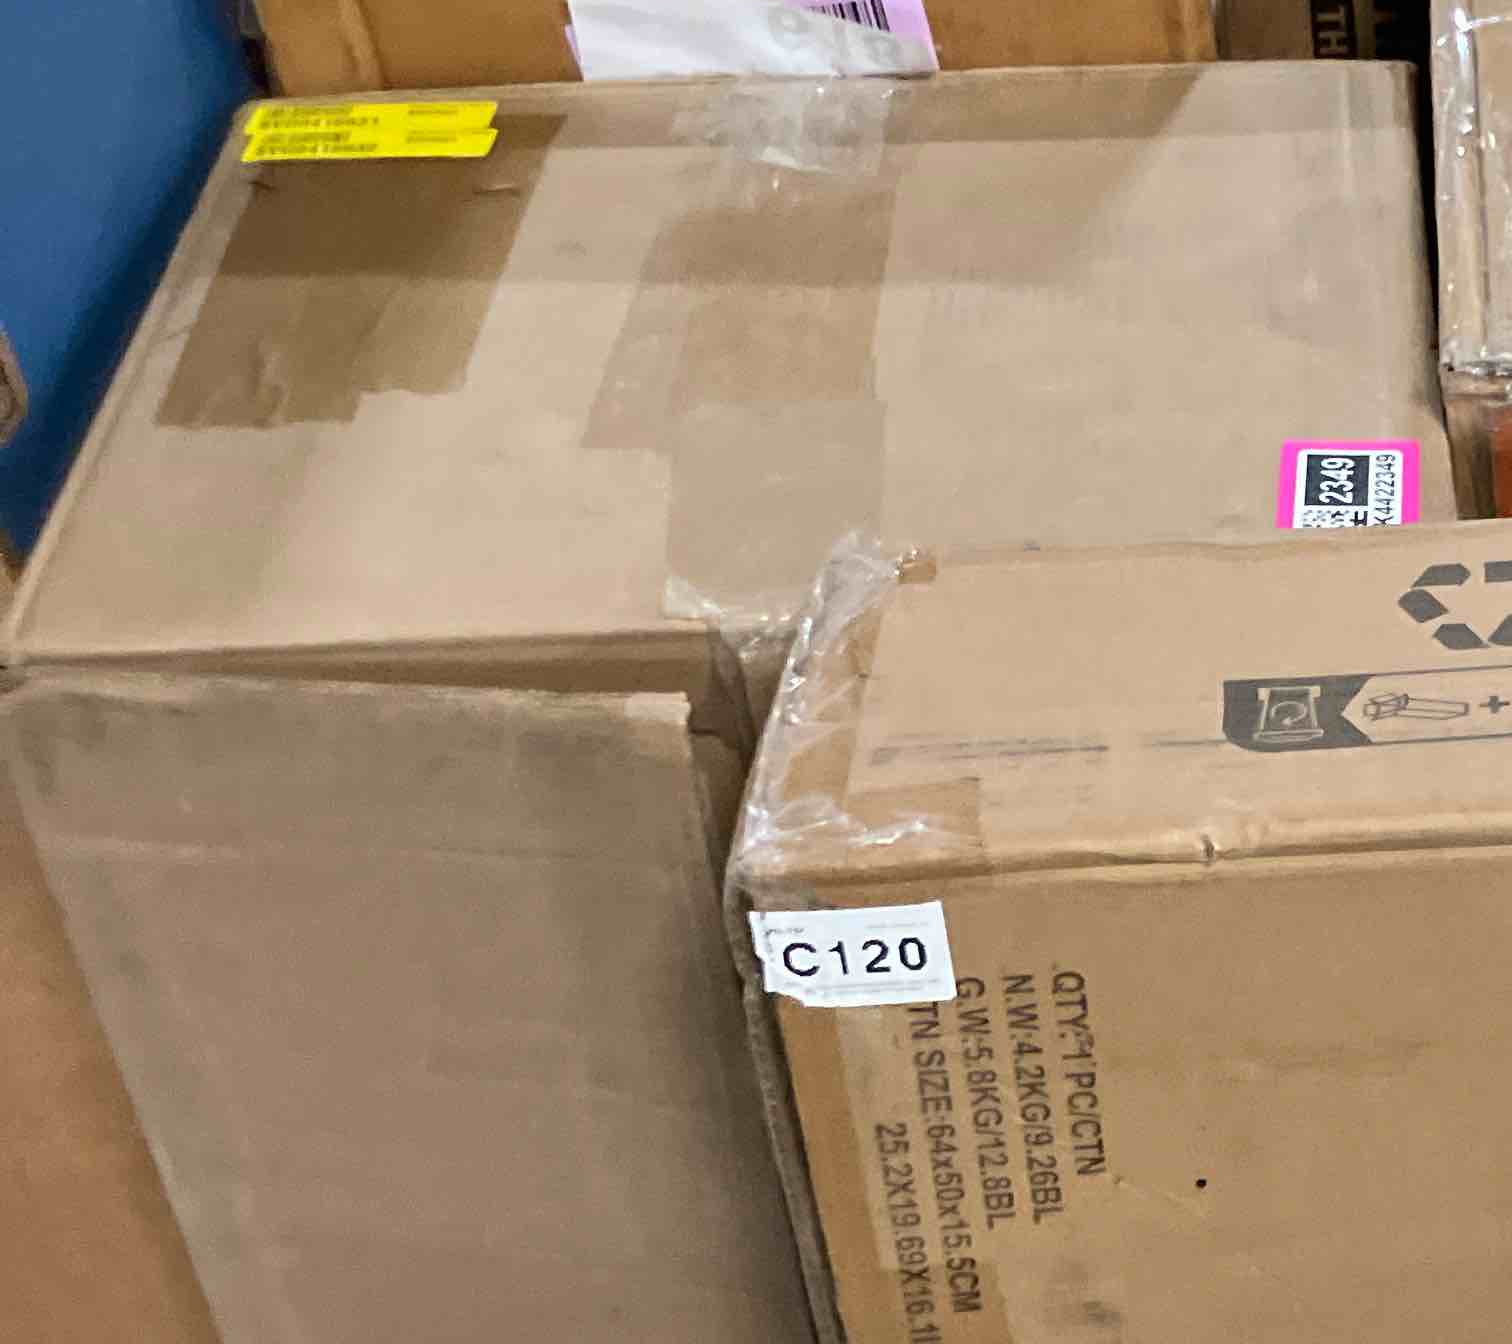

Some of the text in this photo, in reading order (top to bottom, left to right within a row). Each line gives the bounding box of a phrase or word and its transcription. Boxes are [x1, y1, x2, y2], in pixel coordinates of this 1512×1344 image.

[1318, 457, 1355, 504] 2349
[783, 937, 928, 977] C120
[907, 1001, 943, 1041] TN
[1063, 1071, 1106, 1176] PC/CTN
